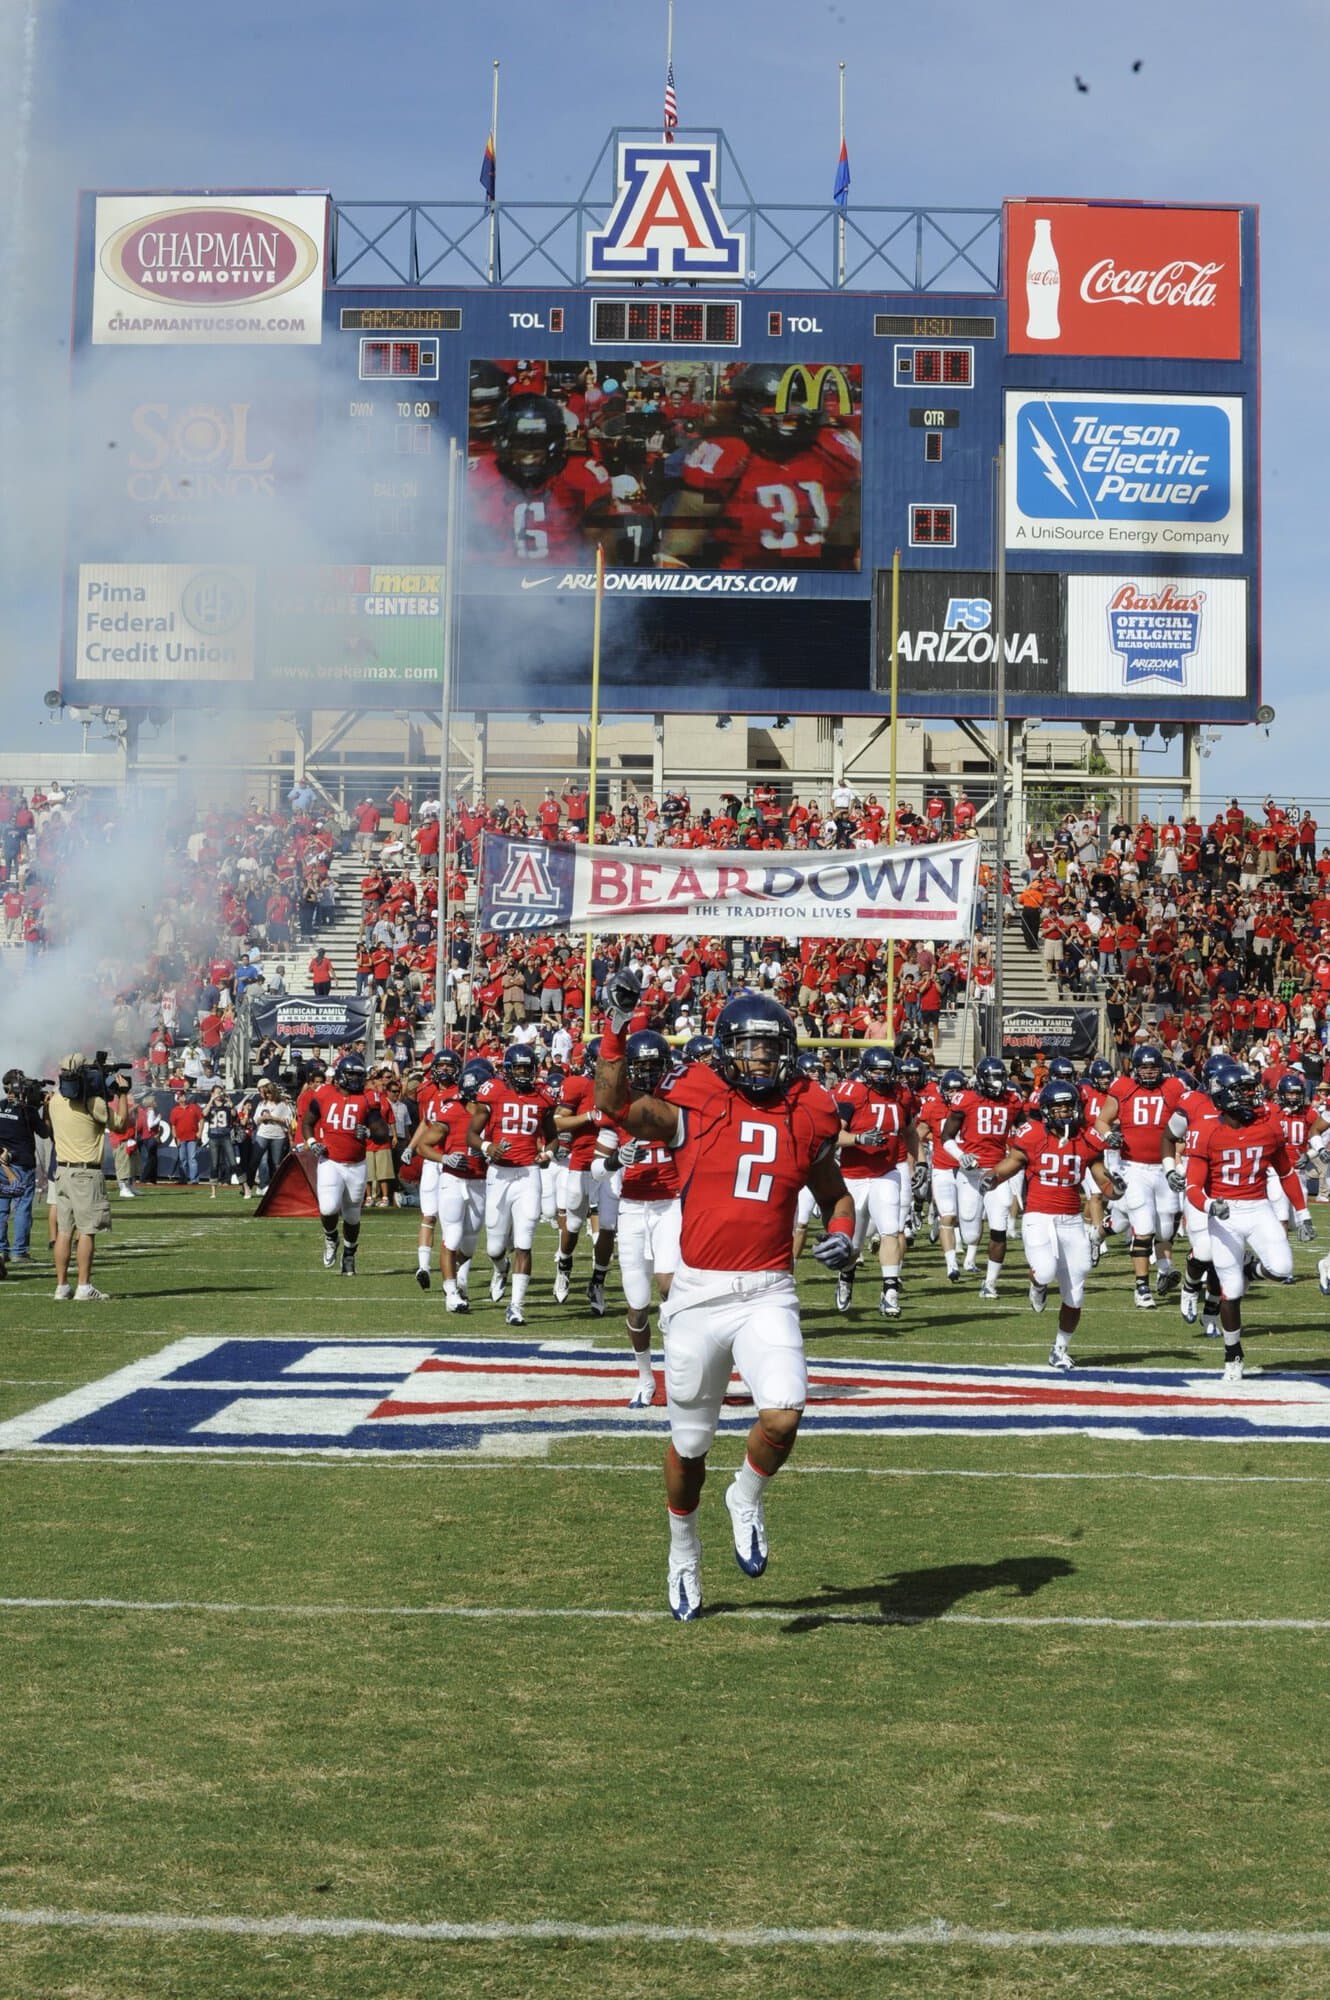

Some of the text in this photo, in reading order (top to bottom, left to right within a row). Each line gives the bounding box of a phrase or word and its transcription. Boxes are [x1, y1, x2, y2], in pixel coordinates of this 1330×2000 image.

[138, 232, 279, 268] CHAPMAN
[141, 270, 276, 283] AUTOMOTIVE
[1080, 258, 1225, 306] Coca-Cola
[108, 318, 304, 331] CHAPMANTUCSON.COM
[362, 311, 441, 329] ARIZONA
[510, 313, 545, 329] TOL
[788, 316, 823, 333] TOL
[914, 318, 952, 335] WSU
[397, 402, 430, 417] TO GO
[923, 410, 945, 426] QTR
[1072, 416, 1180, 447] Tucson
[1082, 446, 1210, 475] Electric
[1095, 475, 1209, 505] Power
[757, 481, 829, 550] 31
[1016, 526, 1230, 546] A UniSource Energy Company
[88, 582, 146, 602] Pima
[373, 574, 441, 594] max
[557, 573, 798, 592] ARIZONAWILDCATS.COM
[364, 596, 440, 616] CENTERS
[1112, 585, 1203, 611] Bashas'
[87, 611, 175, 632] Federal
[944, 598, 992, 631] FS
[1117, 616, 1193, 629] OFFICIAL
[1116, 629, 1193, 641] TAILGATE
[85, 642, 237, 663] Credit Union
[888, 631, 1040, 664] ARIZONA
[272, 663, 439, 680] www.brakemax.com
[1130, 658, 1179, 668] ARIZONA
[695, 905, 851, 919] THE TRADITION LIVES
[1004, 1019, 1073, 1027] AMERICAN FAMILY
[326, 1102, 359, 1131] 46
[502, 1103, 538, 1135] 26
[871, 1103, 900, 1137] 71
[977, 1106, 1008, 1135] 83
[1133, 1096, 1165, 1126] 67
[733, 1120, 779, 1203] 2
[1039, 1153, 1081, 1187] 23
[1221, 1146, 1264, 1186] 27
